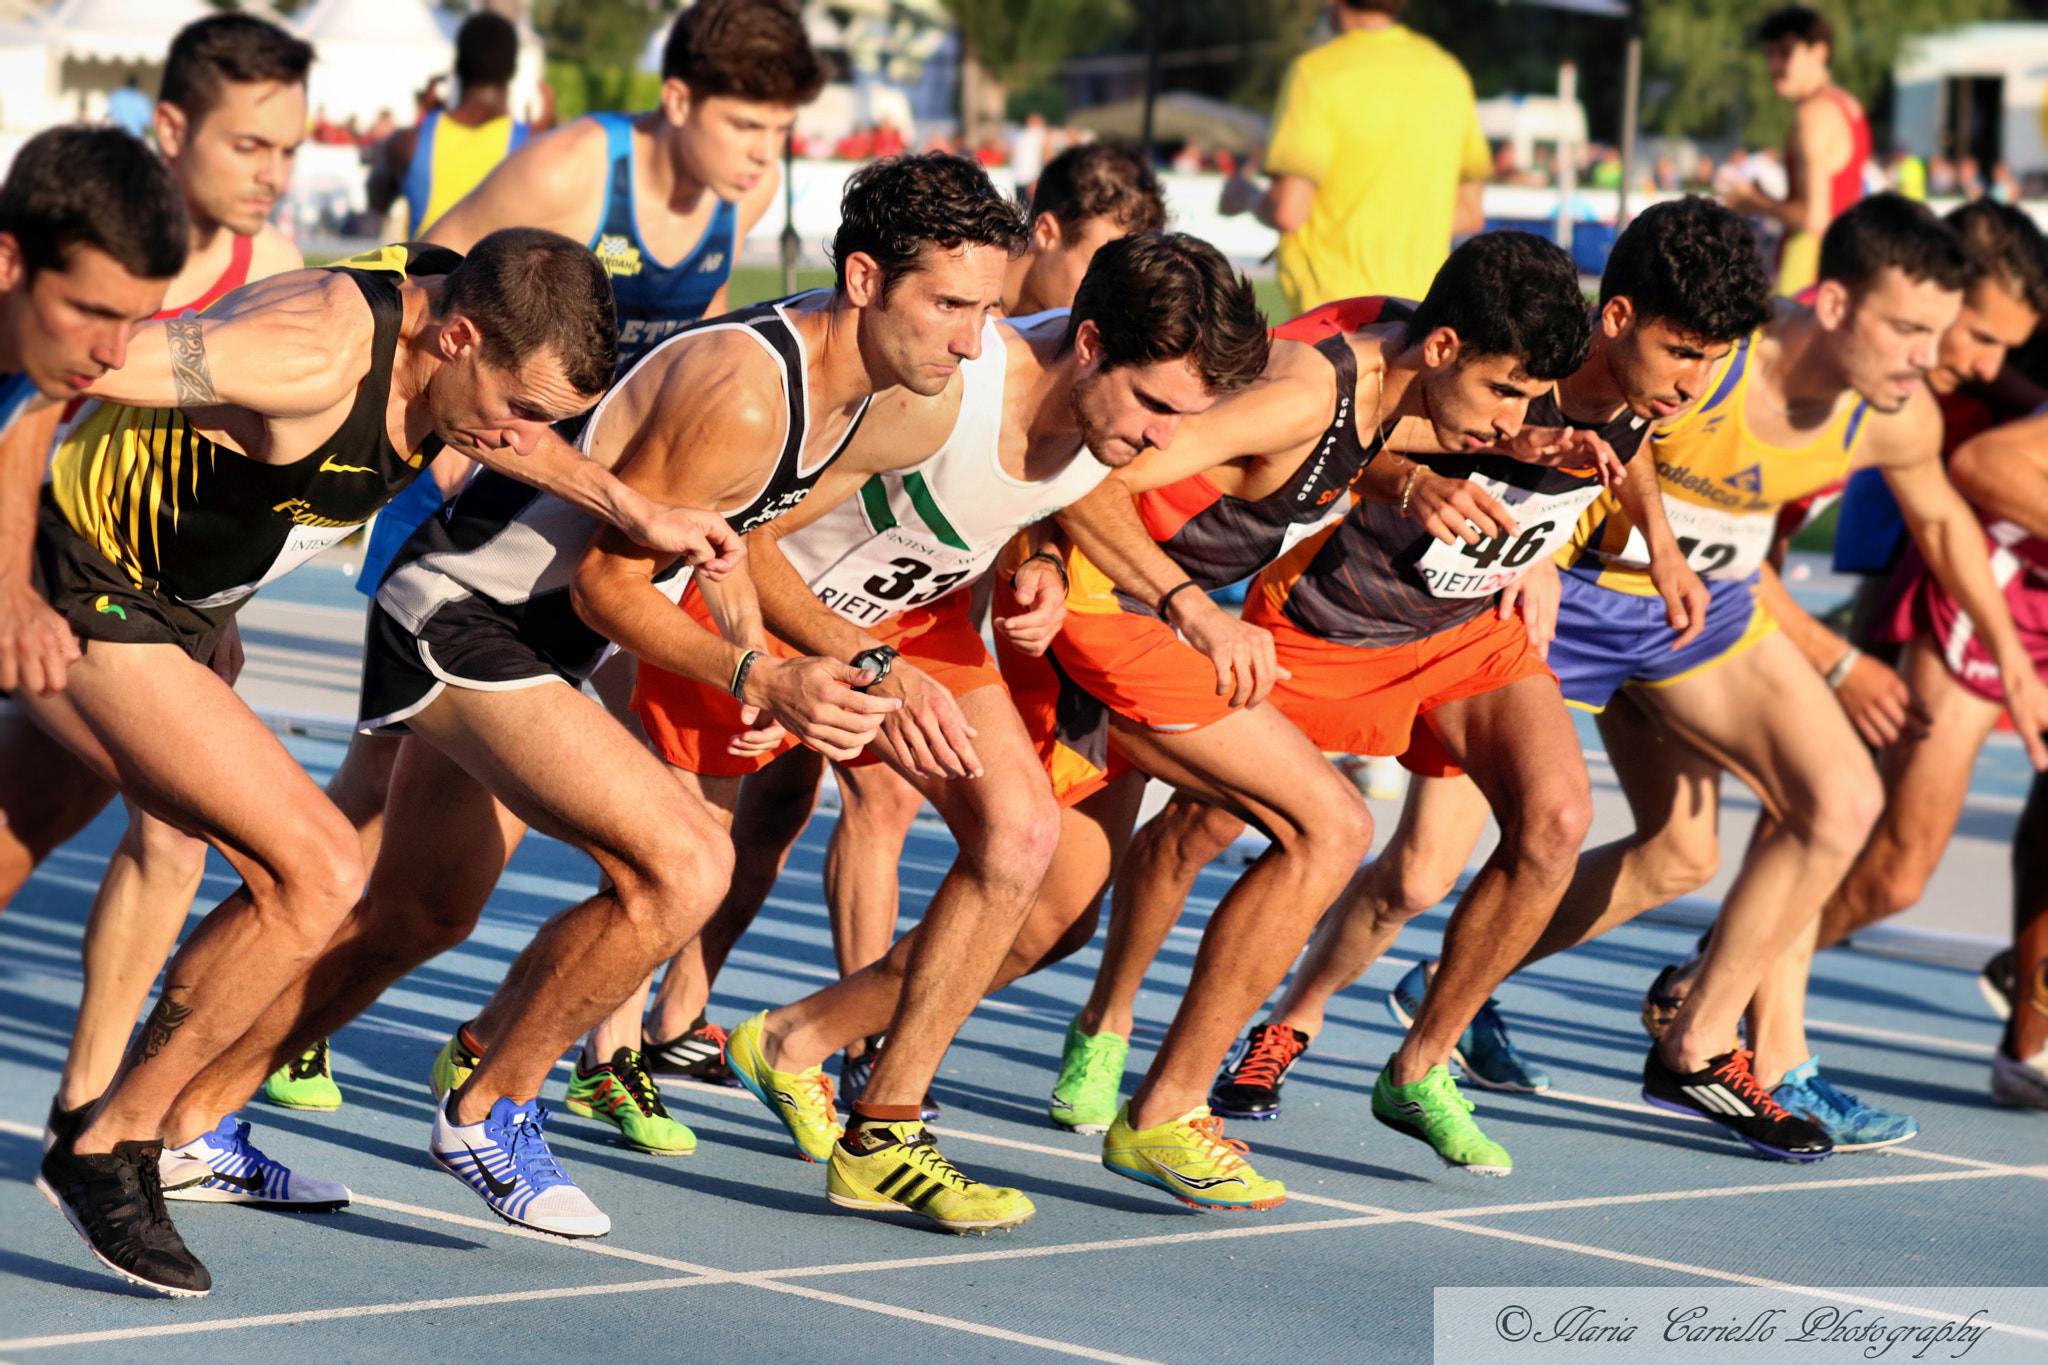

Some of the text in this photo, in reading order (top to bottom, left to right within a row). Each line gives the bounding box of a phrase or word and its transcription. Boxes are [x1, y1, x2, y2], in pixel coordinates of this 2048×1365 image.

[1297, 397, 1350, 501] CUS PALERMO
[1461, 520, 1555, 569] 46
[818, 586, 888, 623] RIETI
